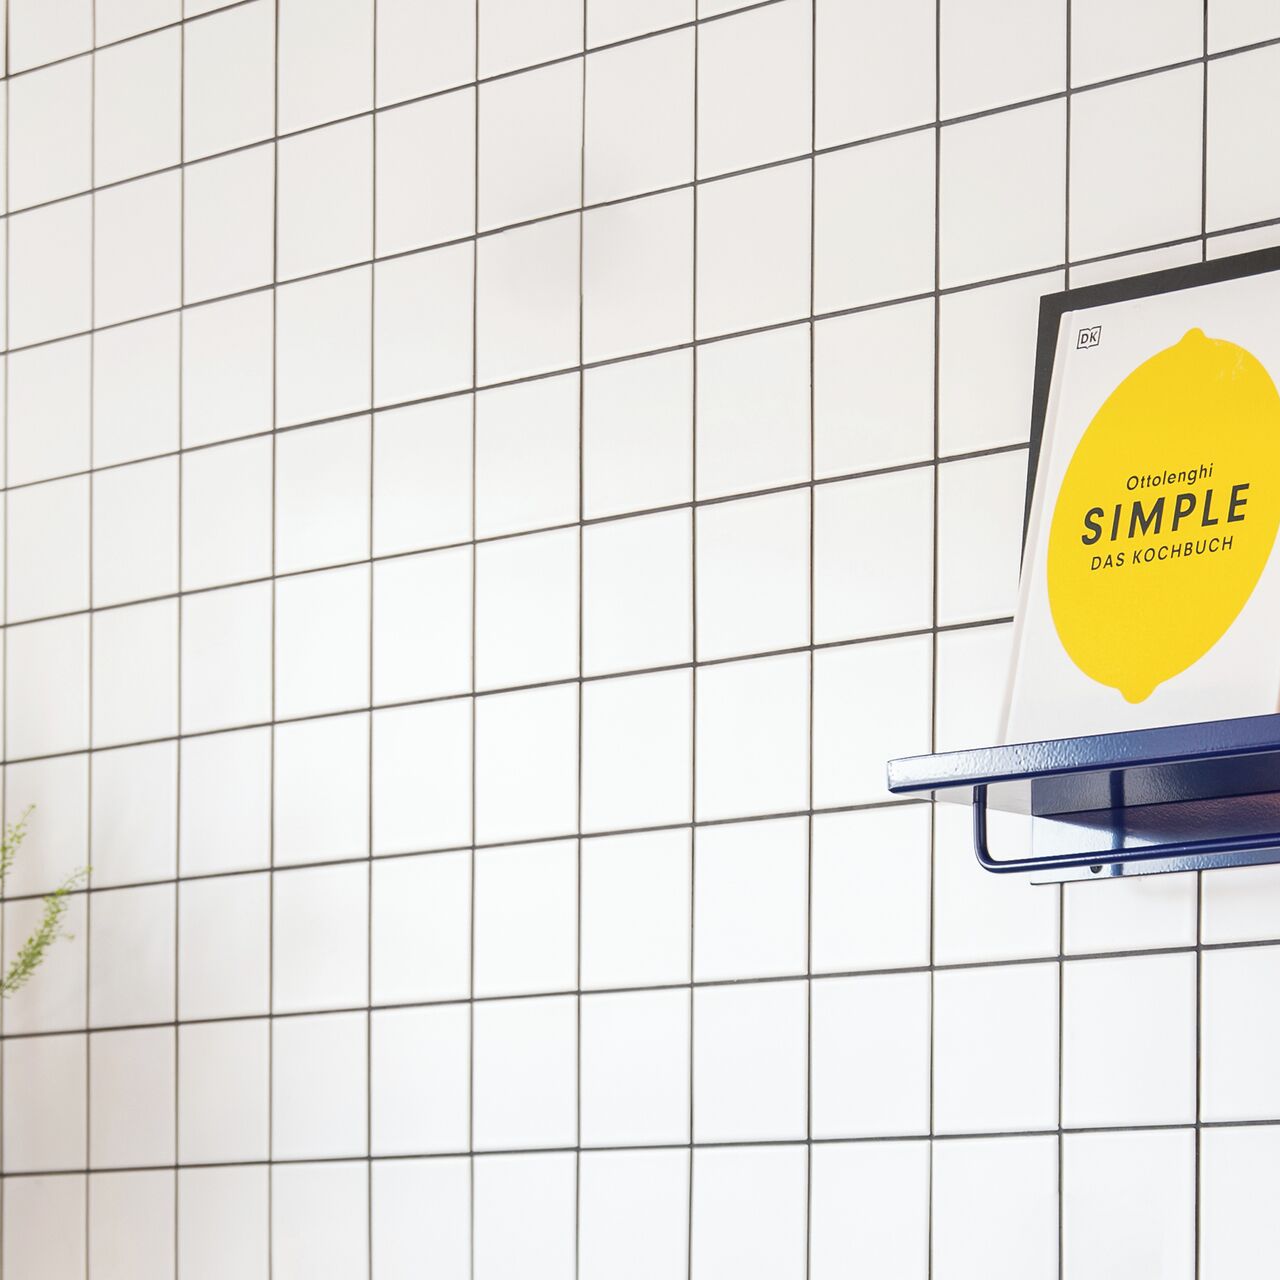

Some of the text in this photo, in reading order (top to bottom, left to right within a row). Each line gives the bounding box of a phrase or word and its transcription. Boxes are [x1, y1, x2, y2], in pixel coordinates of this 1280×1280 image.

[1080, 330, 1099, 345] DK
[1126, 462, 1214, 491] Ottolenghi
[1081, 483, 1250, 546] SIMPLE
[1090, 535, 1234, 571] DAS KOCHBUCH
